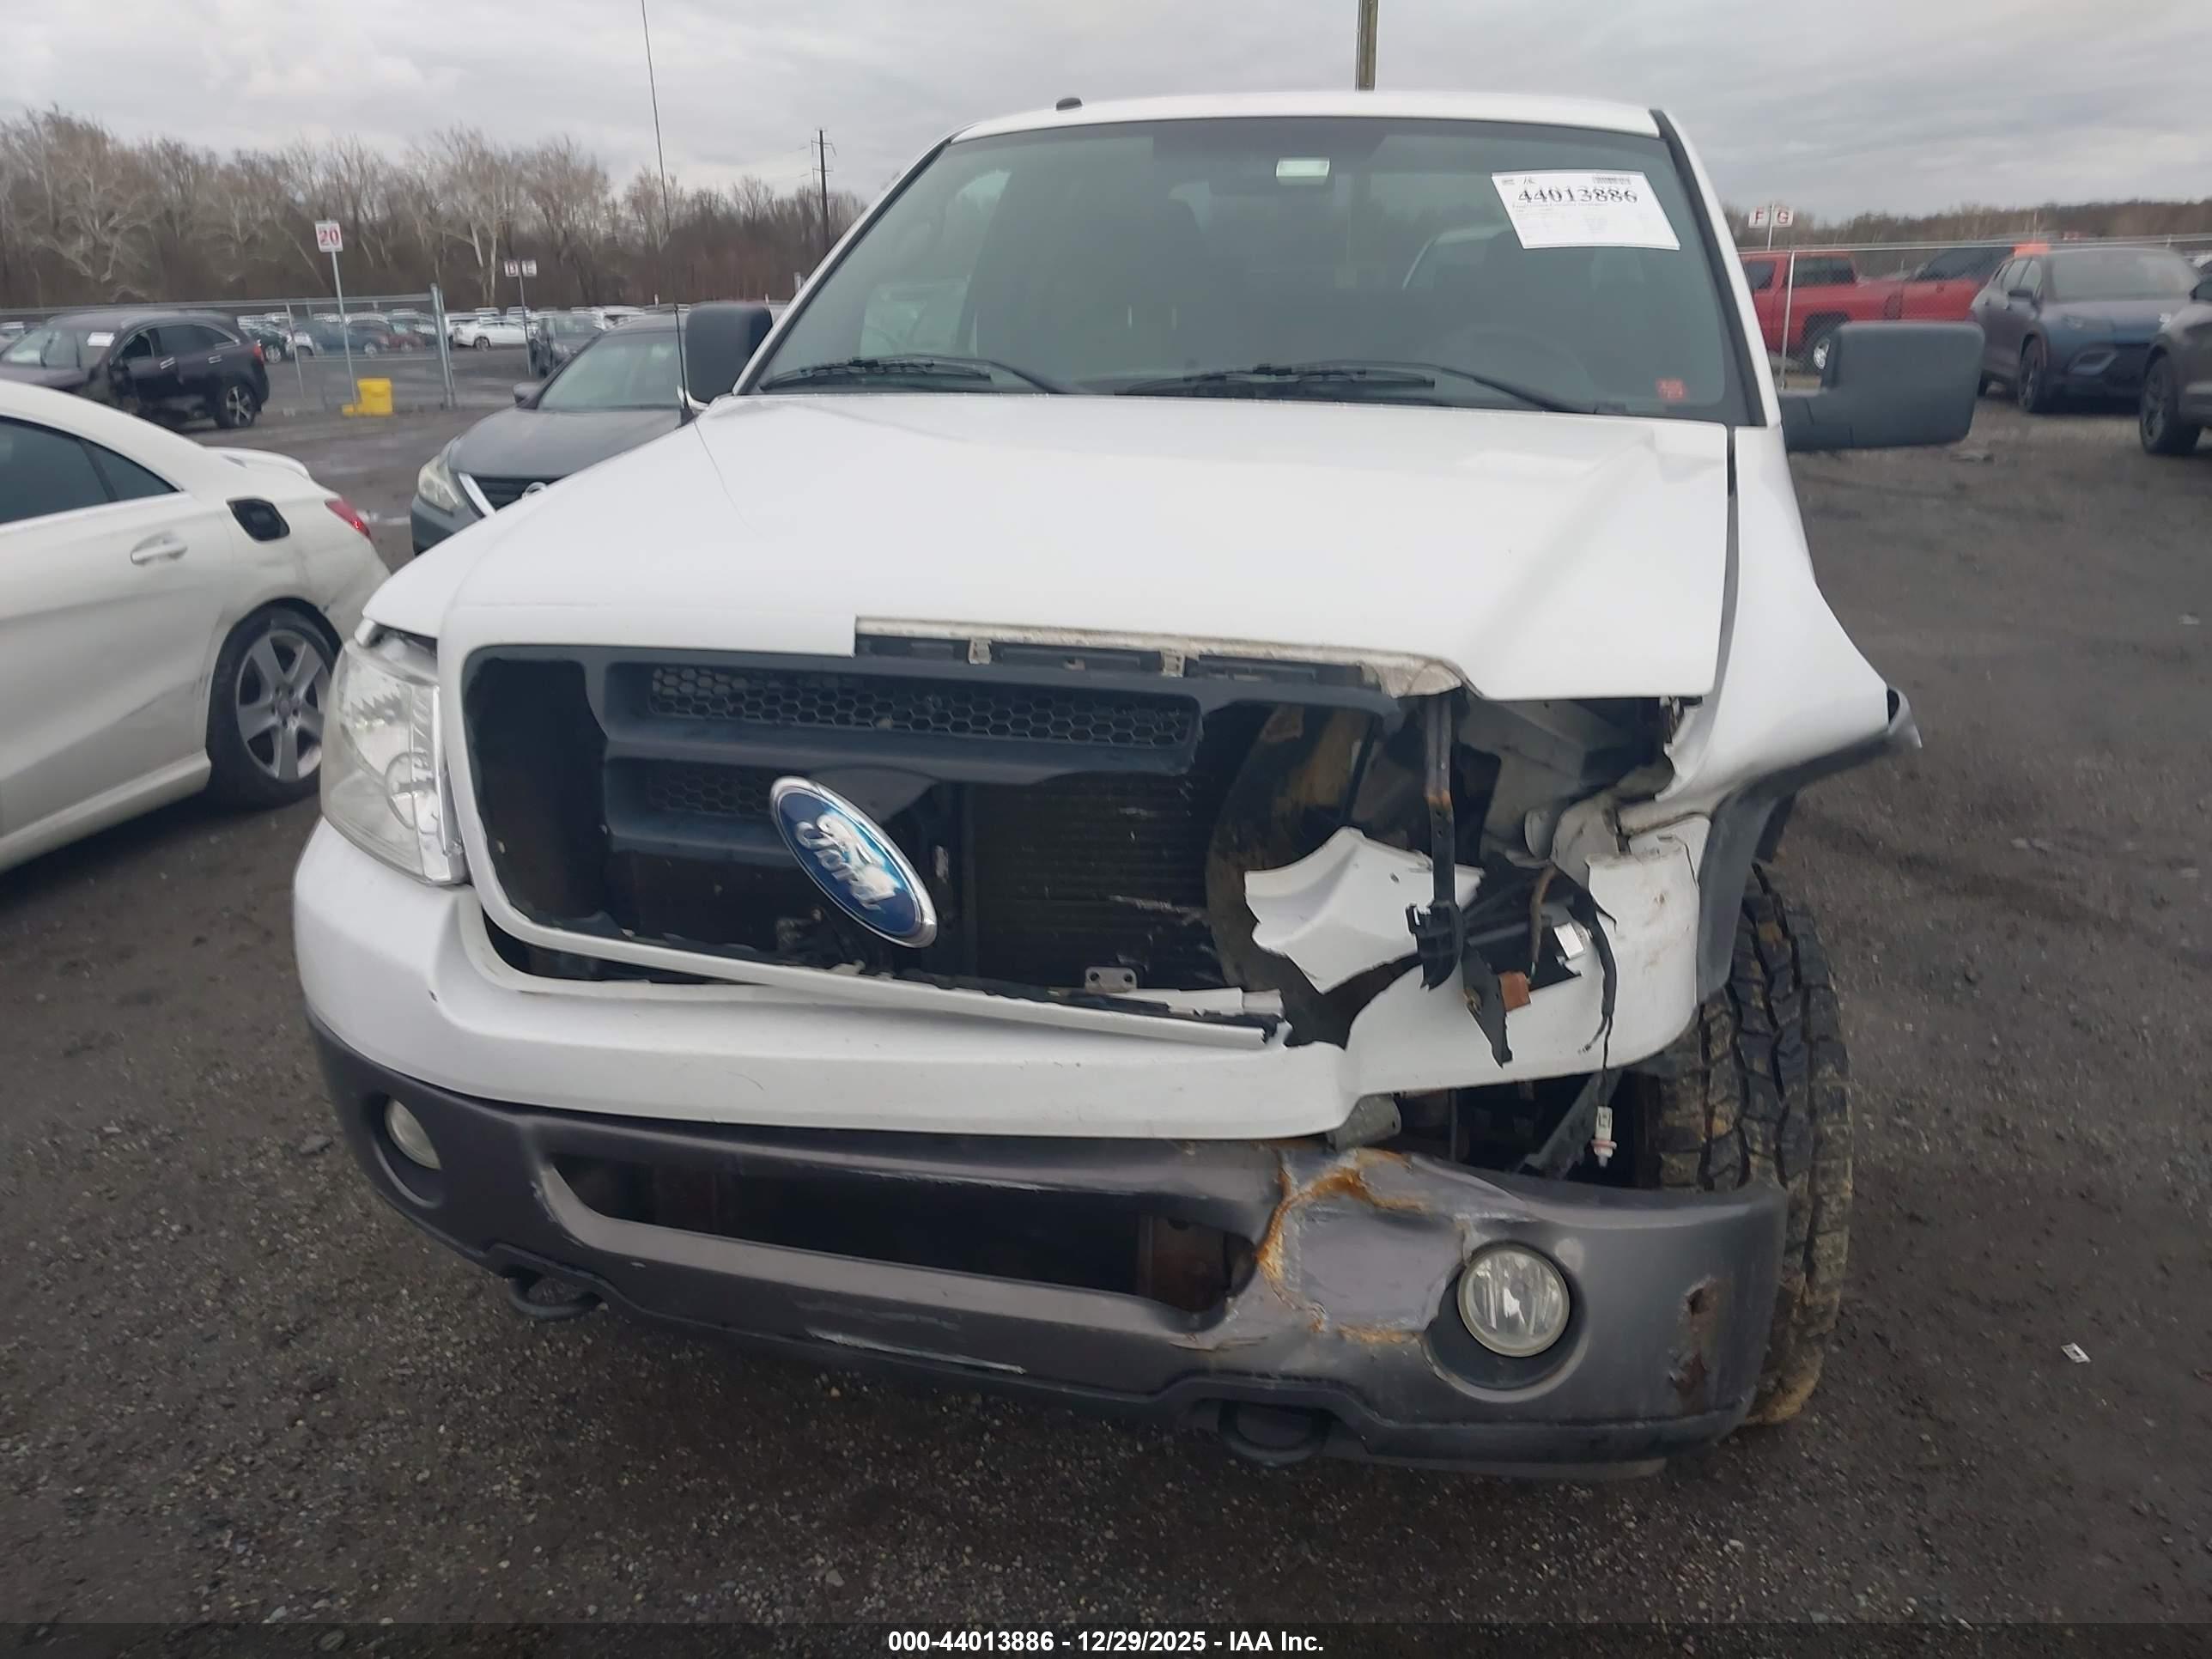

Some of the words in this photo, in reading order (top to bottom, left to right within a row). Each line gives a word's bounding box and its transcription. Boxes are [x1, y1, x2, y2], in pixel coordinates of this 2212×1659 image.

[1517, 186, 1638, 204] 44013886
[1754, 207, 1764, 224] F
[1777, 207, 1789, 224] G
[319, 227, 340, 246] 20
